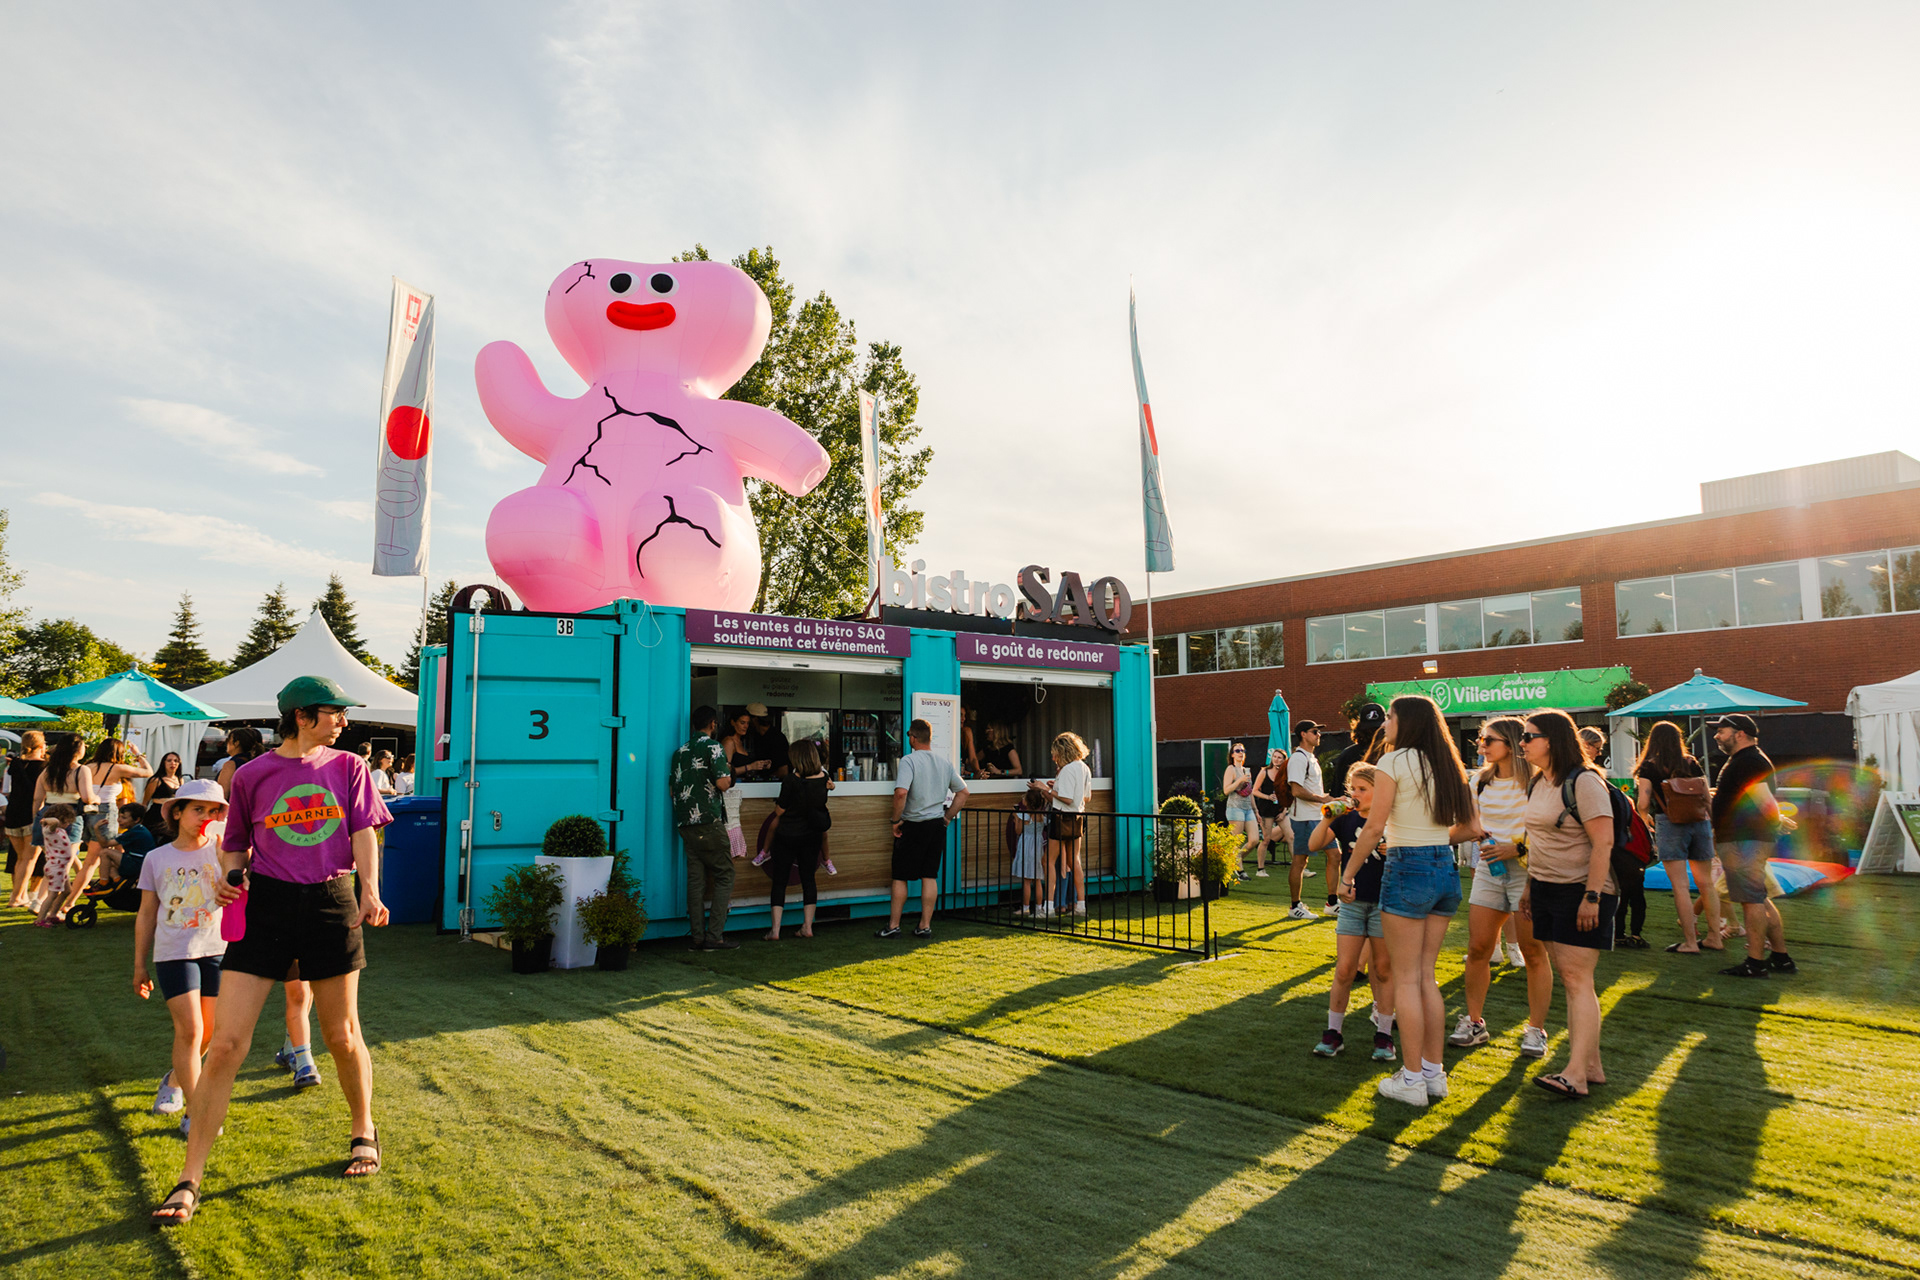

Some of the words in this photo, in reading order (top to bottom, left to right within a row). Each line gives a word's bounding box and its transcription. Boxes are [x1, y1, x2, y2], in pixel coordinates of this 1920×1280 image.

[880, 555, 1016, 618] bistro
[1017, 564, 1132, 634] SAQ
[558, 619, 573, 635] 3B
[714, 614, 739, 629] Les
[743, 619, 789, 633] ventes
[793, 621, 810, 635] du
[815, 623, 853, 638] bistro
[857, 626, 886, 641] SAQ
[713, 631, 792, 648] soutiennent
[796, 635, 817, 649] cet
[820, 637, 889, 654] événement.
[975, 639, 987, 655] le
[991, 642, 1024, 660] goût
[1027, 644, 1044, 659] de
[1047, 647, 1104, 663] redonner
[766, 690, 795, 698] redonner
[1453, 684, 1547, 703] Villeneuve
[124, 698, 166, 709] SAQ
[939, 700, 951, 708] SAQ
[1668, 702, 1708, 710] SAQ
[528, 709, 550, 740] 3
